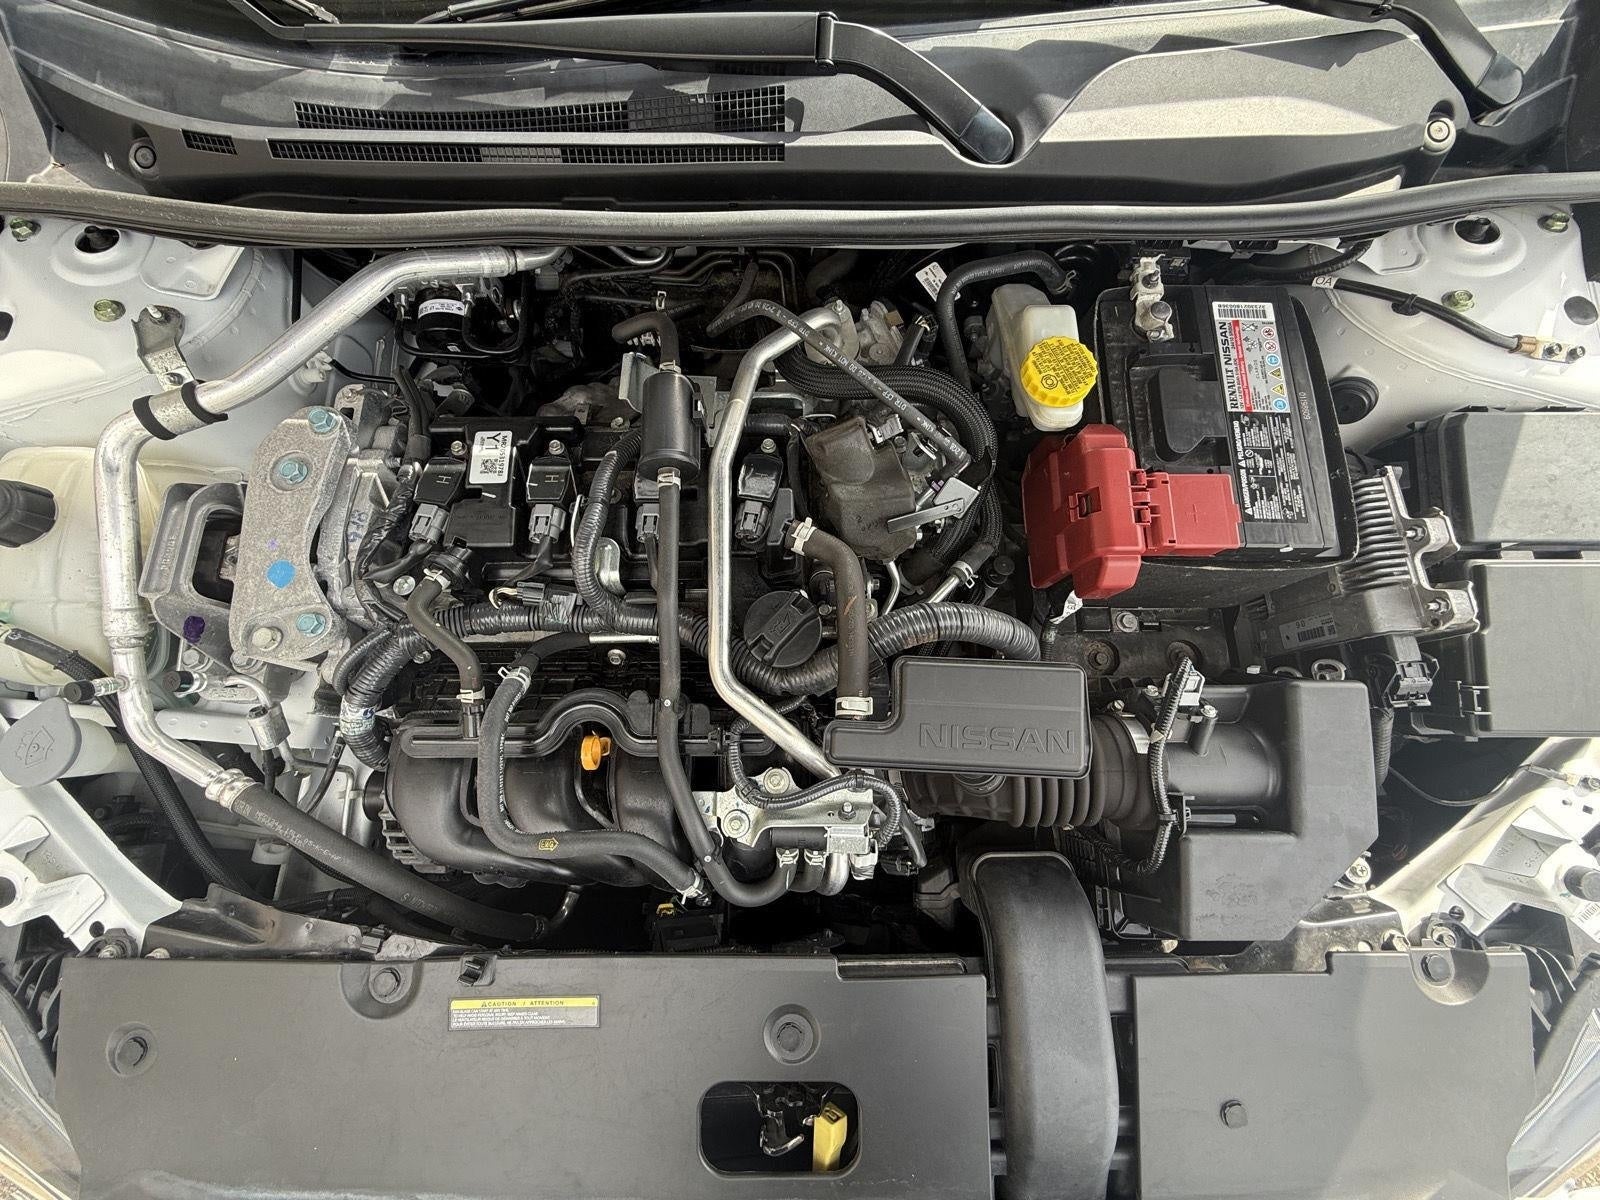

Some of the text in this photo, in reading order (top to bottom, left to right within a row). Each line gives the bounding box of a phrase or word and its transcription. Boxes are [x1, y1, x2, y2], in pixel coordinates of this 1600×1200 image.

[1218, 321, 1238, 408] RENAULT NISSAN
[485, 432, 500, 449] Y1
[918, 722, 1075, 753] NISSAN
